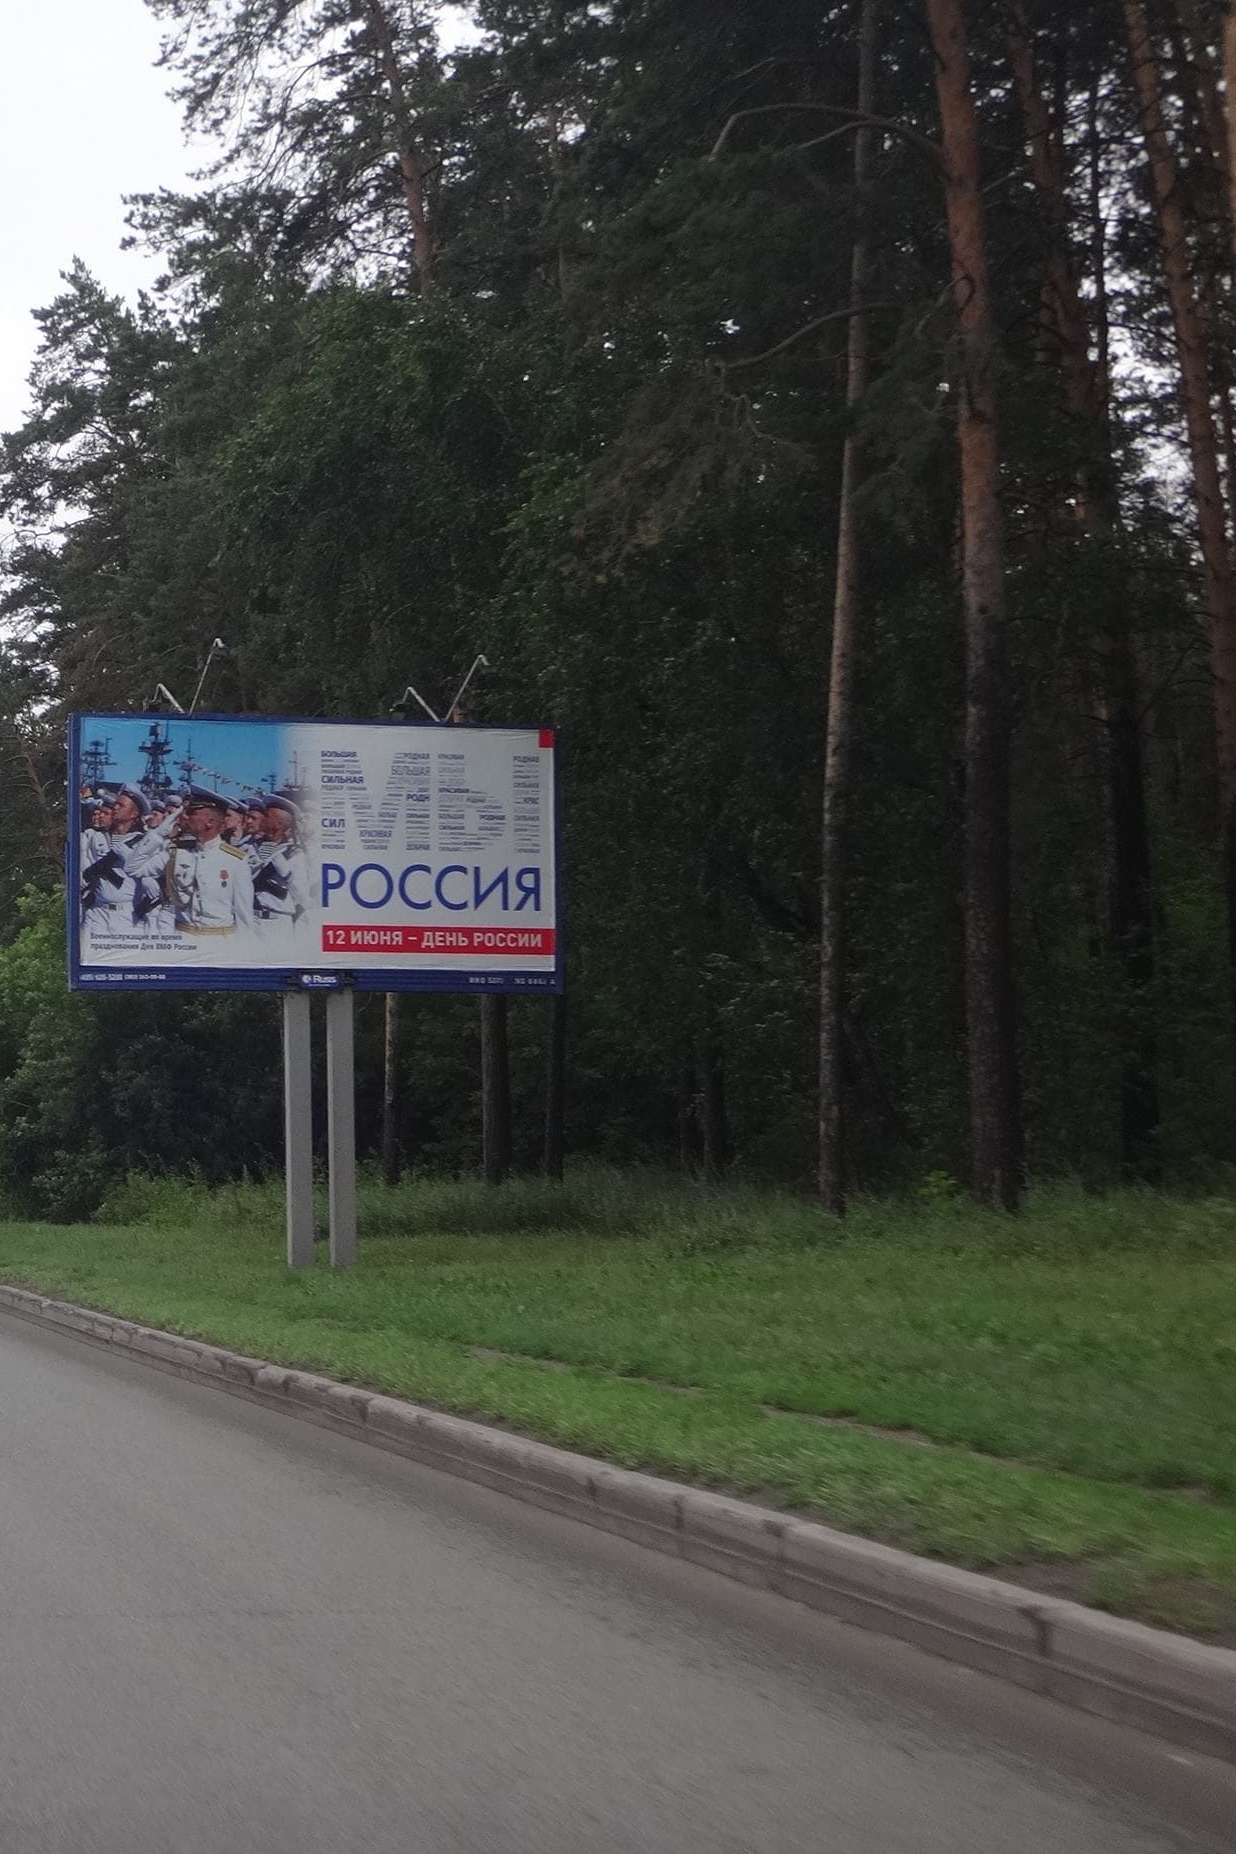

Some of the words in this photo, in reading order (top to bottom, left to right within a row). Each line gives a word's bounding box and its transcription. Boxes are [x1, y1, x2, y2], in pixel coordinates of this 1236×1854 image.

[321, 776, 364, 784] СИЛЬНАЯ
[321, 818, 345, 828] СИЛ
[321, 863, 541, 911] РОССИЯ
[91, 932, 149, 941] Военнослужащие
[326, 930, 345, 945] 12
[350, 931, 403, 946] ИЮНЯ
[421, 932, 468, 948] ДЕНЬ
[473, 933, 542, 948] РОССИИ
[313, 974, 337, 983] Russ
